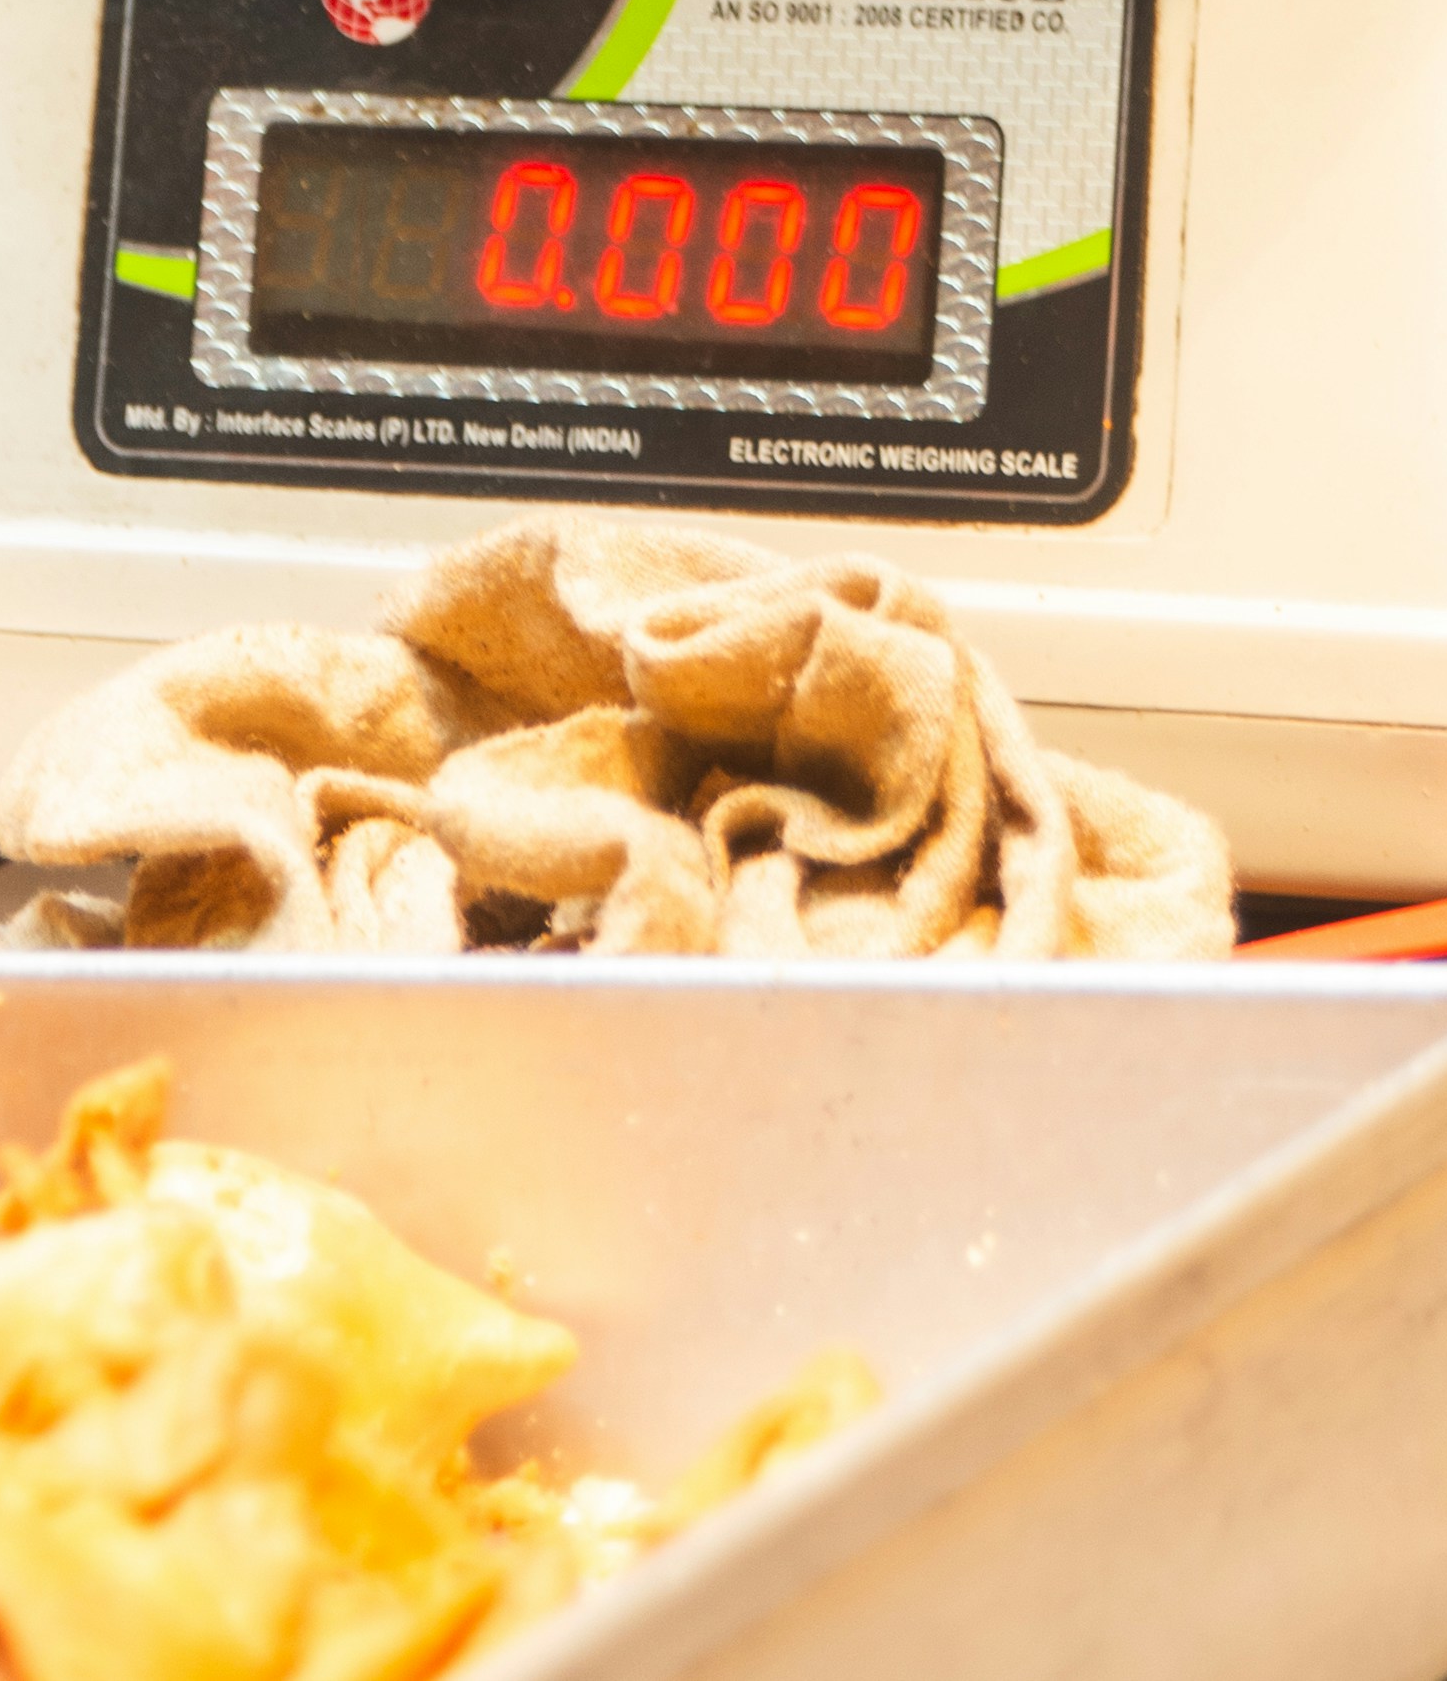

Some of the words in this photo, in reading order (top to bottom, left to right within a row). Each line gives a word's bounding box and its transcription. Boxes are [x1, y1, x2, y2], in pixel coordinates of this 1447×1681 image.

[787, 2, 832, 26] 9001
[855, 3, 903, 28] 2008
[910, 7, 1025, 32] CERTIFIED
[1031, 10, 1070, 35] CO.
[476, 161, 922, 331] 0.000
[172, 405, 202, 438] By
[216, 409, 305, 438] Interface
[308, 412, 377, 441] Scales
[379, 416, 410, 448] (P)
[463, 420, 508, 448] New
[511, 421, 564, 450] Delhi
[567, 425, 642, 459] (INDIA)
[729, 436, 876, 469] ELECTRONIC
[879, 444, 997, 476] WEIGHING
[999, 450, 1079, 480] SCALE
